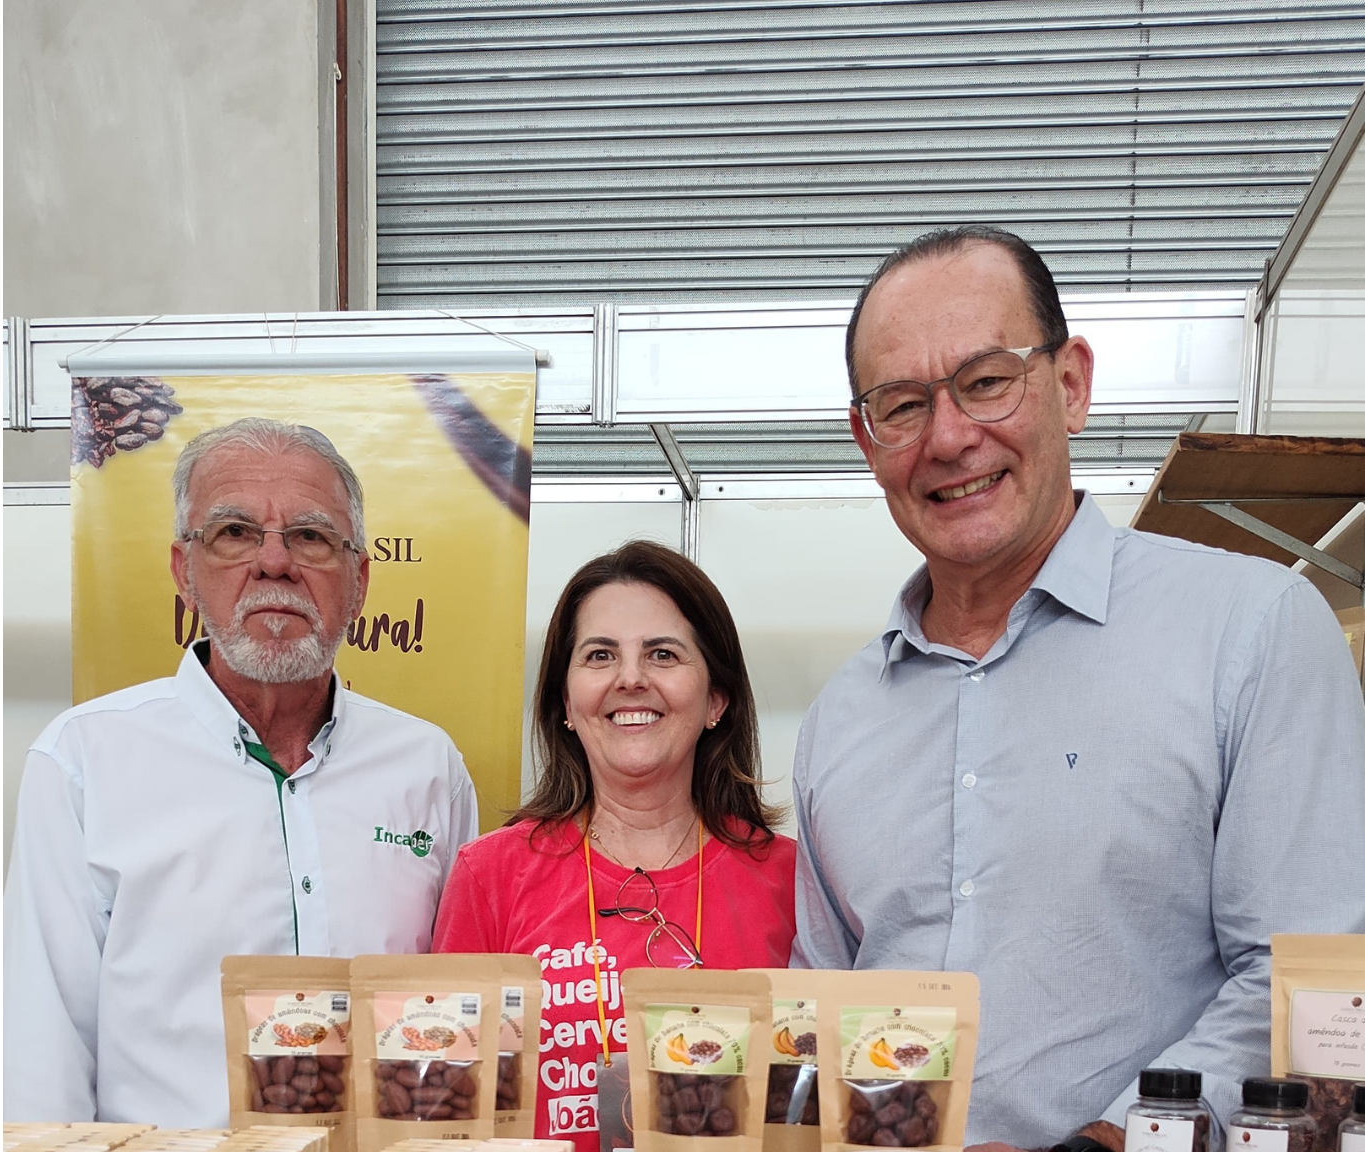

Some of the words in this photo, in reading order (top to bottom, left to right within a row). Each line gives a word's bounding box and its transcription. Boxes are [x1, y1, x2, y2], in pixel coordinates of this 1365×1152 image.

[533, 938, 618, 972] Café,
[538, 971, 624, 1010] Queij
[1331, 1013, 1358, 1023] Casca
[1307, 1027, 1347, 1037] amêndoa
[1349, 1029, 1361, 1038] de
